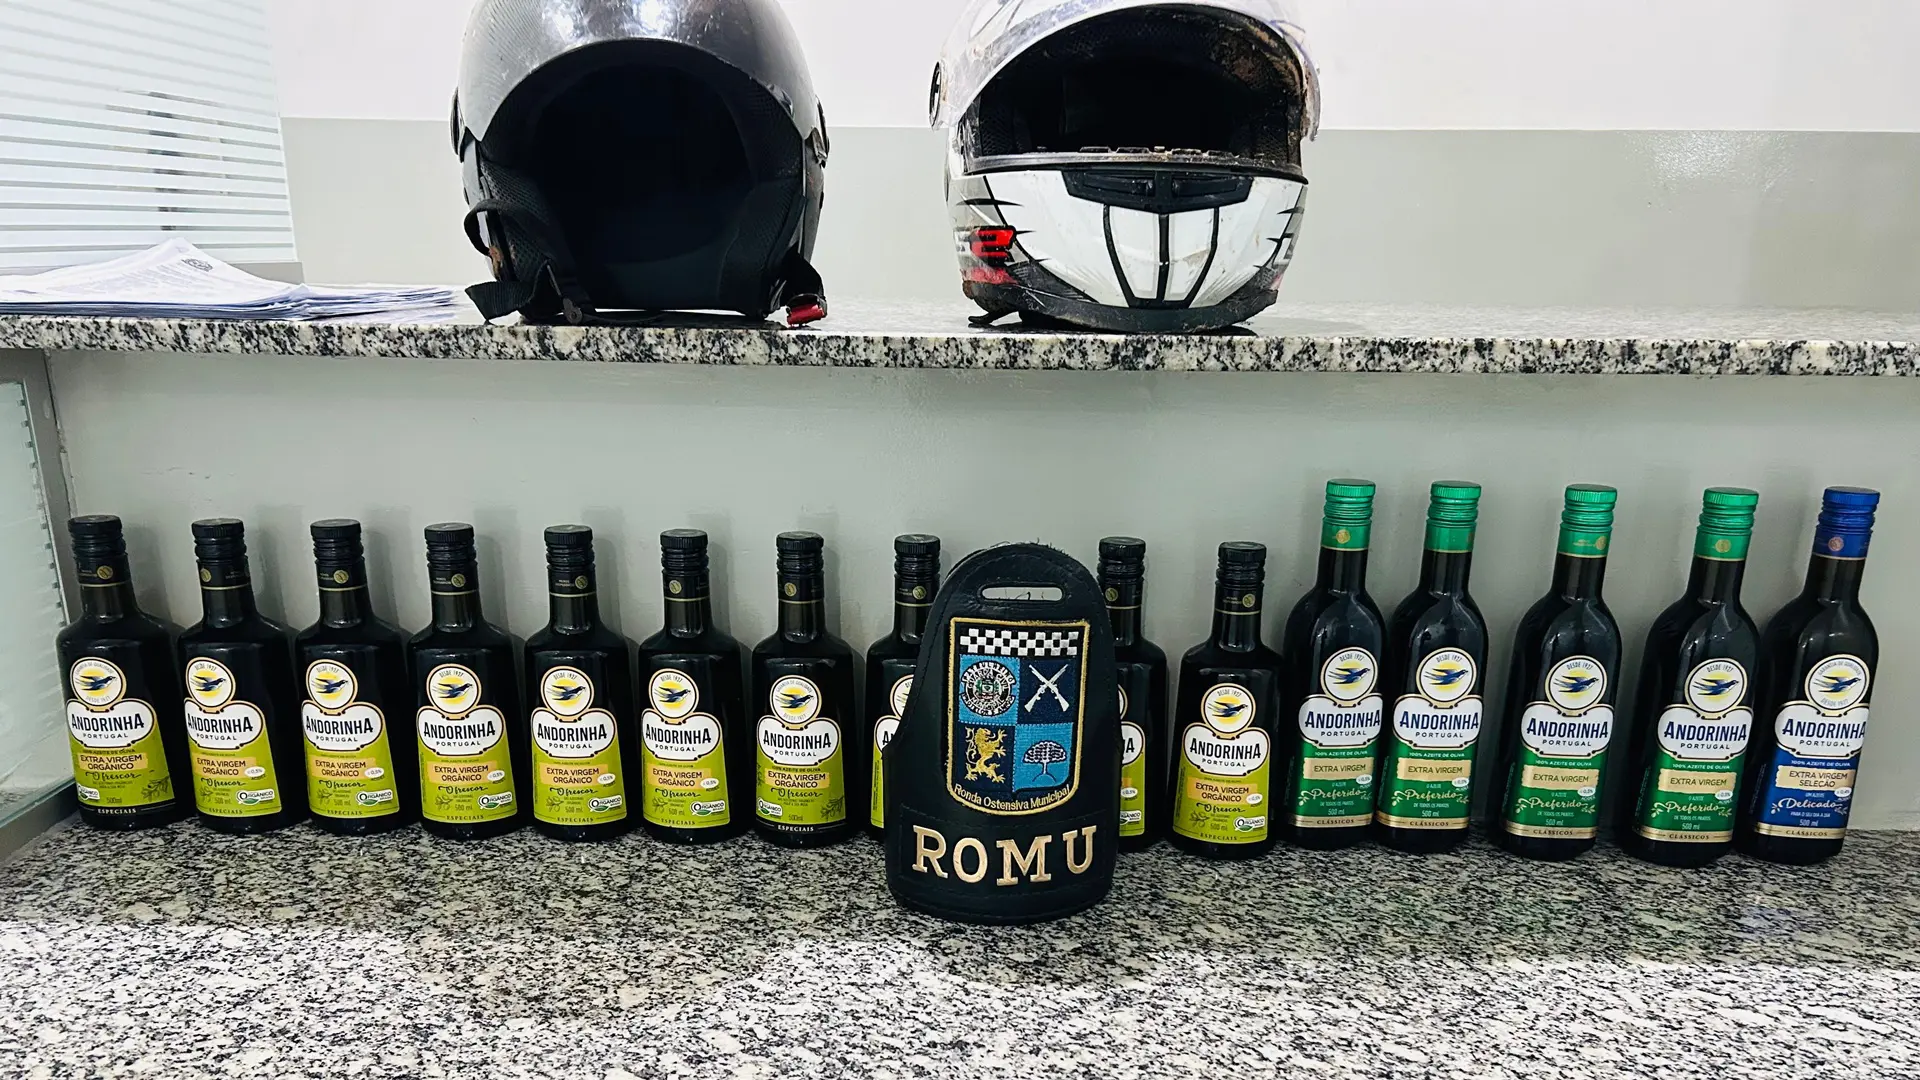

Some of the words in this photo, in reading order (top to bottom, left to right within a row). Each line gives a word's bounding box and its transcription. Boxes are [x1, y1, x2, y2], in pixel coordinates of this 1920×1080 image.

[72, 713, 144, 731] ANDORINHA
[188, 713, 253, 733] ANDORINHA
[306, 715, 373, 735] ANDORINHA
[1305, 710, 1380, 729] ANDORINHA
[1400, 711, 1479, 730] ANDORINHA
[424, 721, 495, 740] ANDORINHA
[537, 723, 607, 742] ANDORINHA
[1527, 718, 1608, 738] ANDORINHA
[1664, 722, 1747, 741] ANDORINHA
[1782, 718, 1866, 739] ANDORINHA
[646, 724, 711, 744] ANDORINHA
[763, 730, 831, 750] ANDORINHA
[1190, 738, 1261, 760] ANDORINHA
[81, 755, 105, 763] EXTRA
[106, 754, 142, 762] VIRGEM
[197, 757, 216, 767] EXTRA
[316, 759, 335, 768] EXTRA
[1202, 759, 1245, 767] PORTUGAL
[88, 762, 134, 770] ORGÂNICO
[203, 766, 239, 775] ORGÂNICO
[434, 765, 457, 774] EXTRA
[459, 765, 488, 773] VIRGEM
[547, 767, 569, 775] EXTRA
[322, 769, 359, 777] ORGÂNICO
[441, 773, 481, 782] ORGÂNICO
[653, 769, 672, 777] EXTRA
[674, 771, 702, 779] VIRGEM
[768, 771, 793, 780] EXTRA
[794, 772, 825, 781] VIRGEM
[1533, 774, 1559, 782] EXTRA
[553, 775, 592, 784] ORGÂNICO
[658, 778, 695, 787] ORGÂNICO
[774, 779, 818, 788] ORGÂNICO
[1196, 782, 1219, 792] EXTRA
[1221, 786, 1249, 794] VIRGEM
[955, 784, 982, 805] Ronda
[983, 796, 1029, 810] Ostensiva
[1030, 784, 1070, 809] Municipal
[1202, 792, 1241, 802] ORGÂNICO
[1309, 789, 1366, 800] Preferido
[1403, 789, 1462, 802] Preferido
[1528, 797, 1588, 809] Preferido
[1663, 801, 1725, 814] Preferido
[1778, 798, 1843, 808] Delicado
[912, 824, 1097, 886] ROMU
